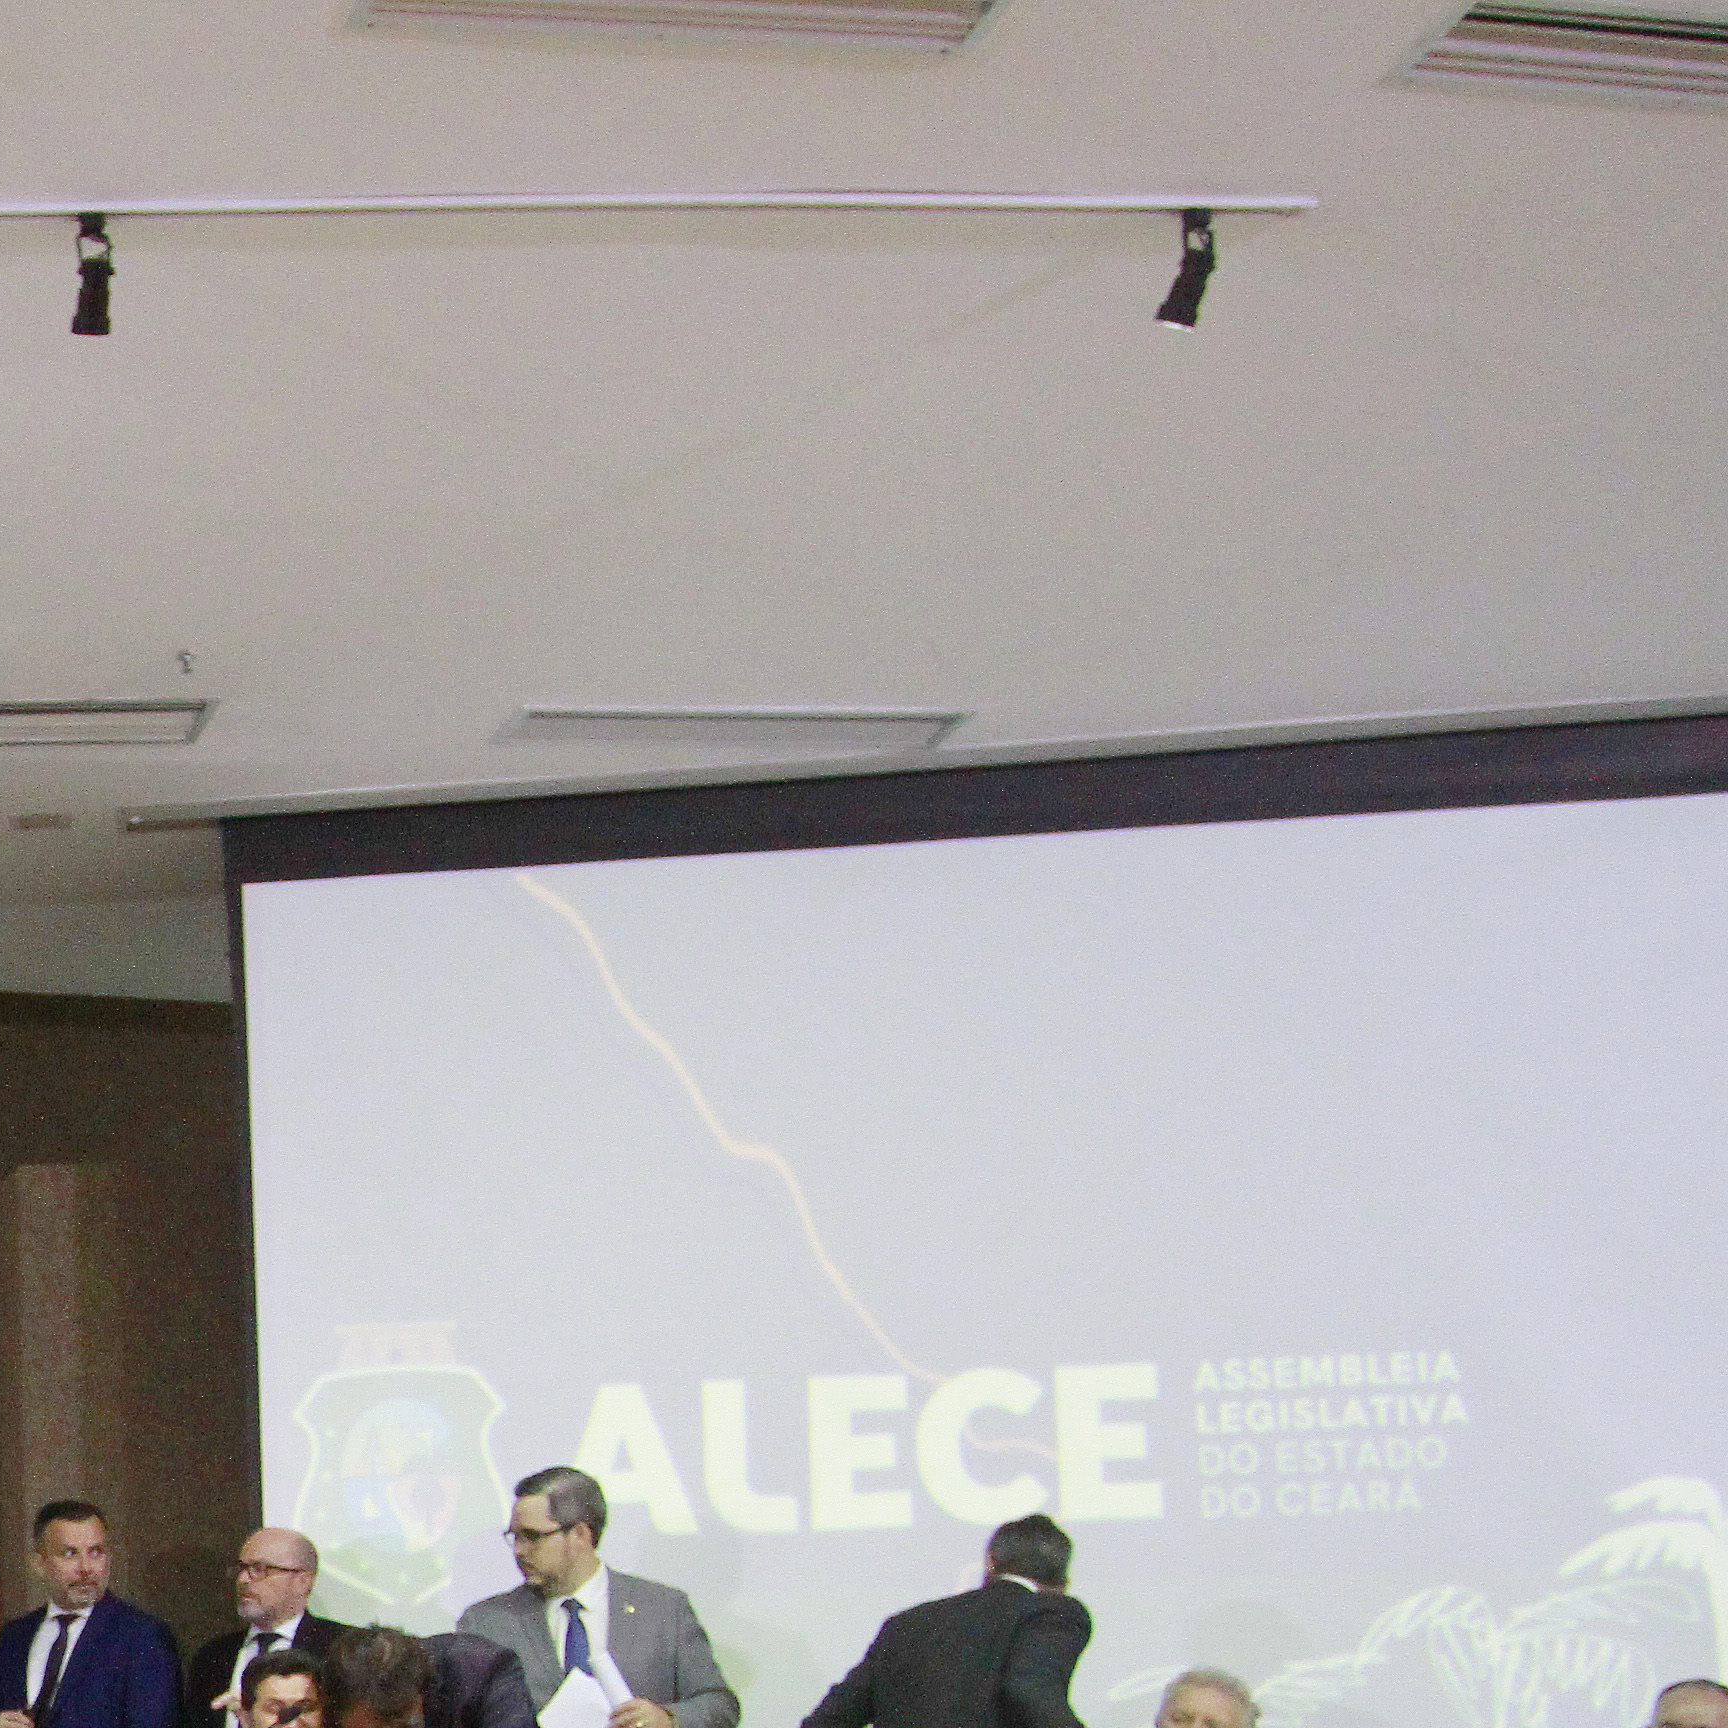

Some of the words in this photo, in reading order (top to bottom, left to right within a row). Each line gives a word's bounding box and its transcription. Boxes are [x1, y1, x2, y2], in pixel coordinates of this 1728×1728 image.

[1194, 1351, 1461, 1391] ASSEMBLEIA
[1196, 1392, 1470, 1435] LEGISLATIVA
[572, 1362, 1164, 1535] ALECE
[1198, 1441, 1258, 1475] DO
[1275, 1435, 1446, 1472] ESTADO
[1201, 1483, 1260, 1519] DO
[1276, 1477, 1422, 1517] CEARÁ
